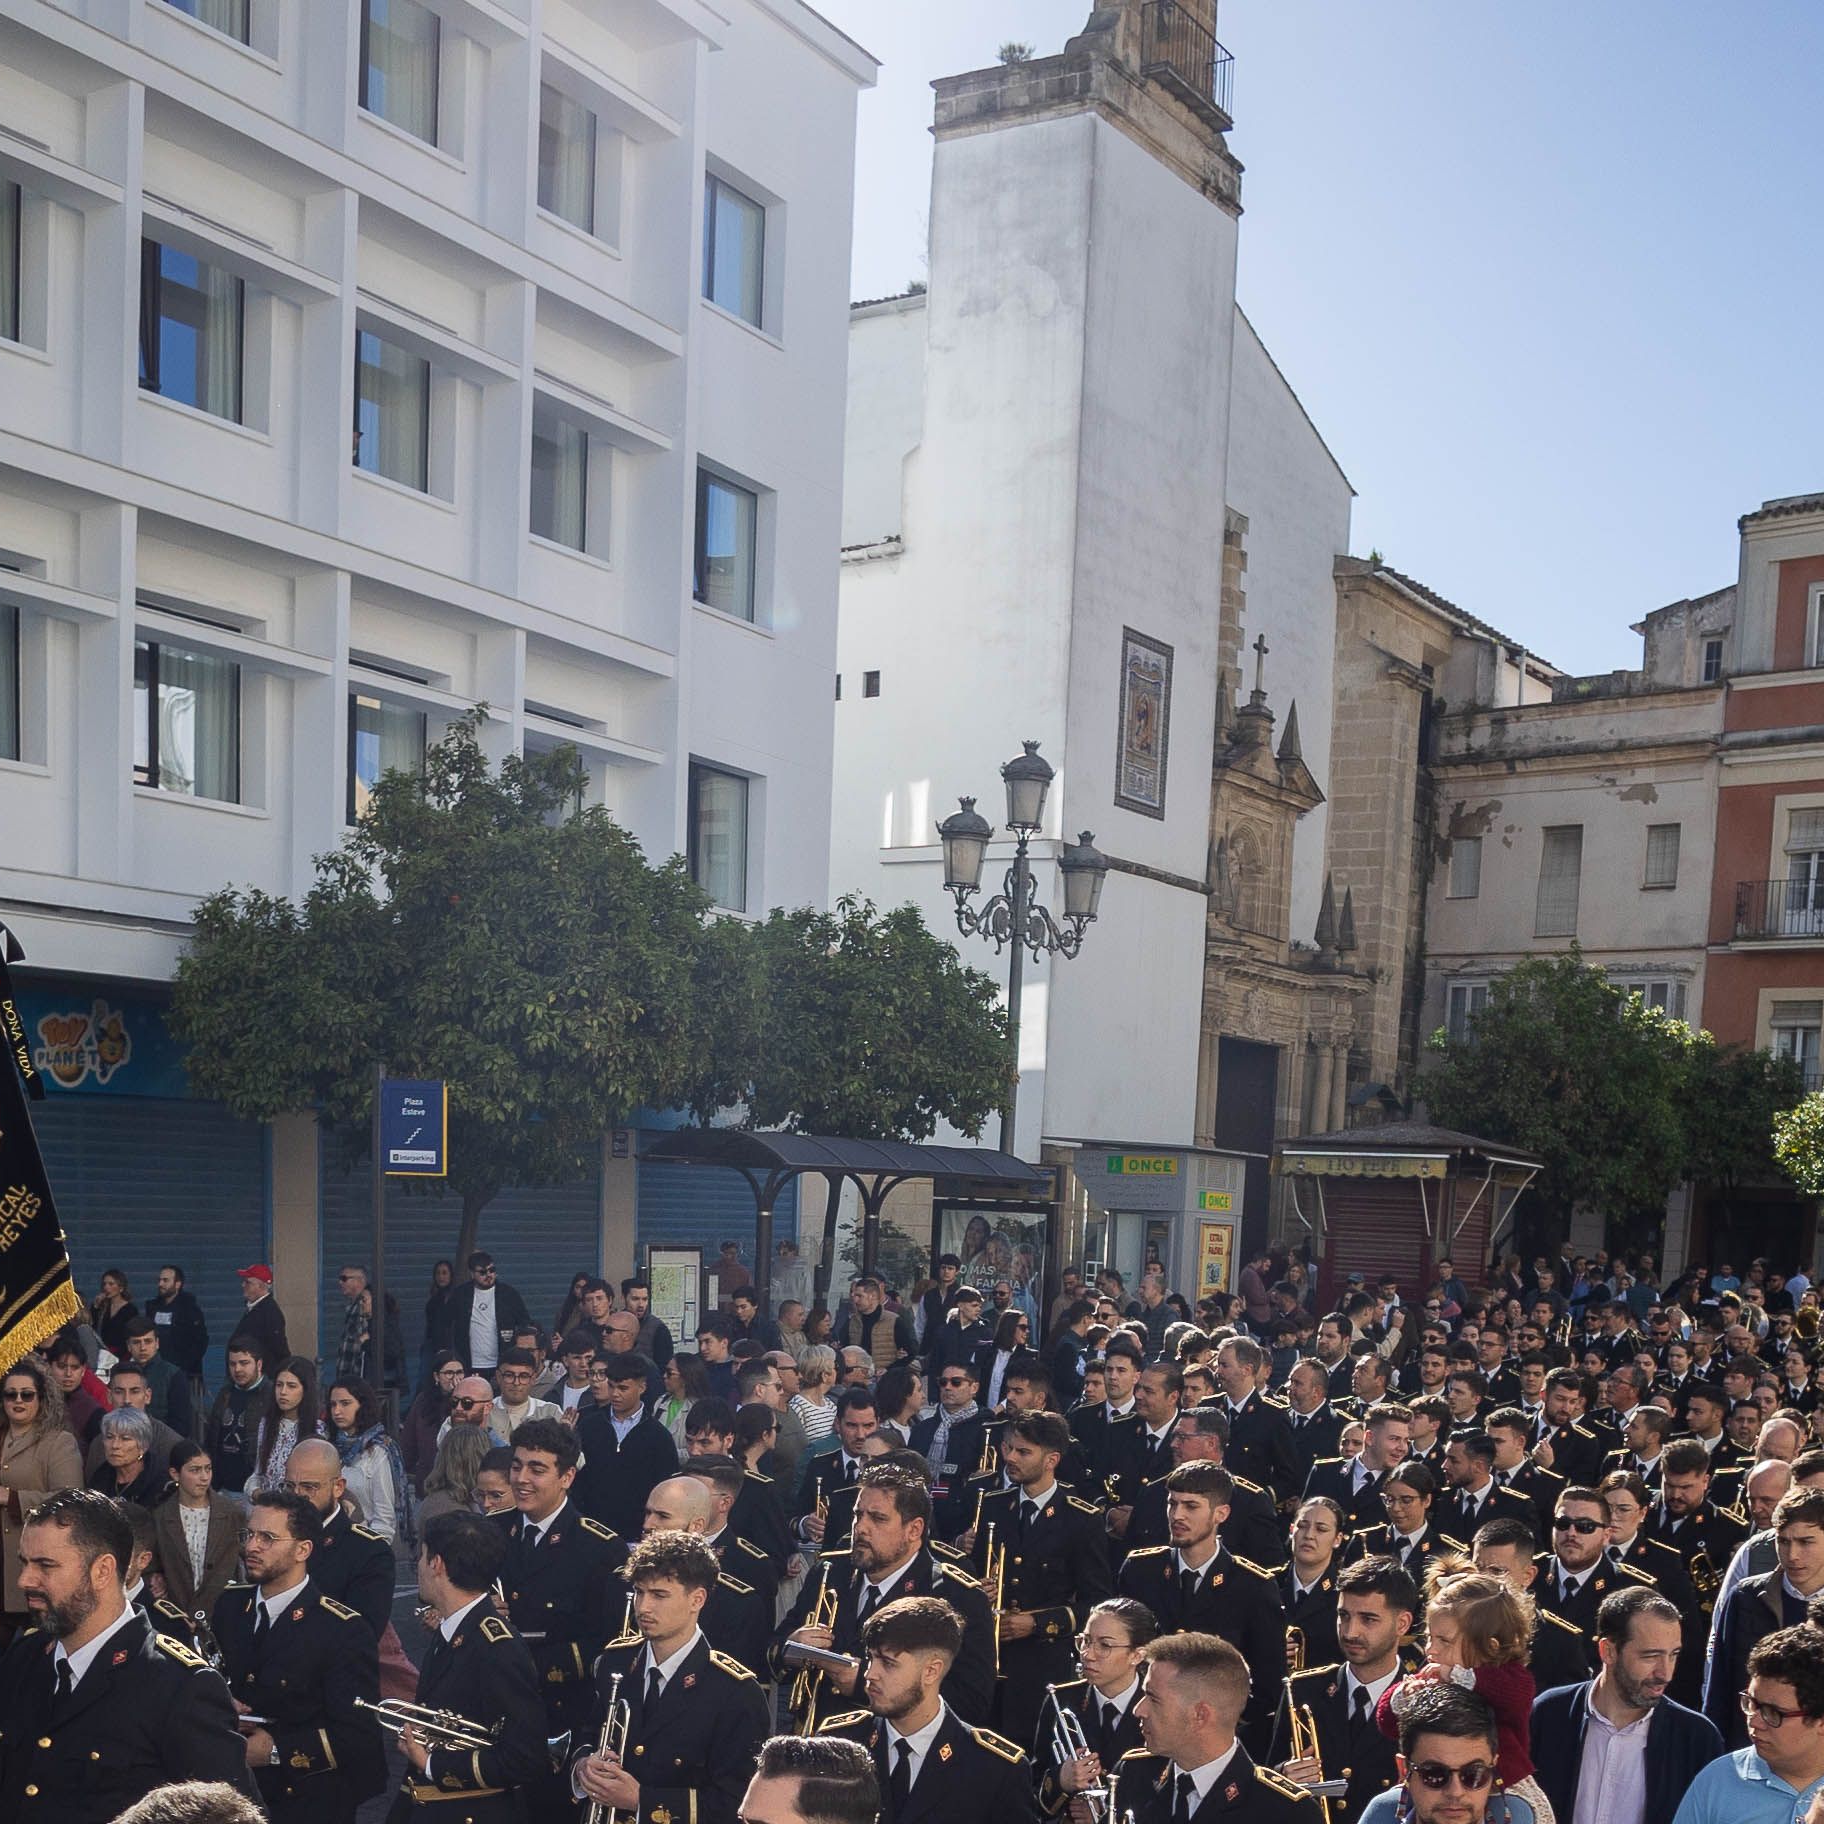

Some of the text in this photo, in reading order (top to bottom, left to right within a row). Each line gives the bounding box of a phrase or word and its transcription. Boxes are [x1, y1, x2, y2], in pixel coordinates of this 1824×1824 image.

[41, 1016, 89, 1047] TOY
[2, 999, 35, 1080] DONA VIDA
[37, 1049, 99, 1067] PLANET
[403, 1097, 424, 1107] Plaza
[401, 1107, 426, 1117] Esteve
[1128, 1159, 1173, 1173] ONCE
[1208, 1194, 1230, 1209] ONCE
